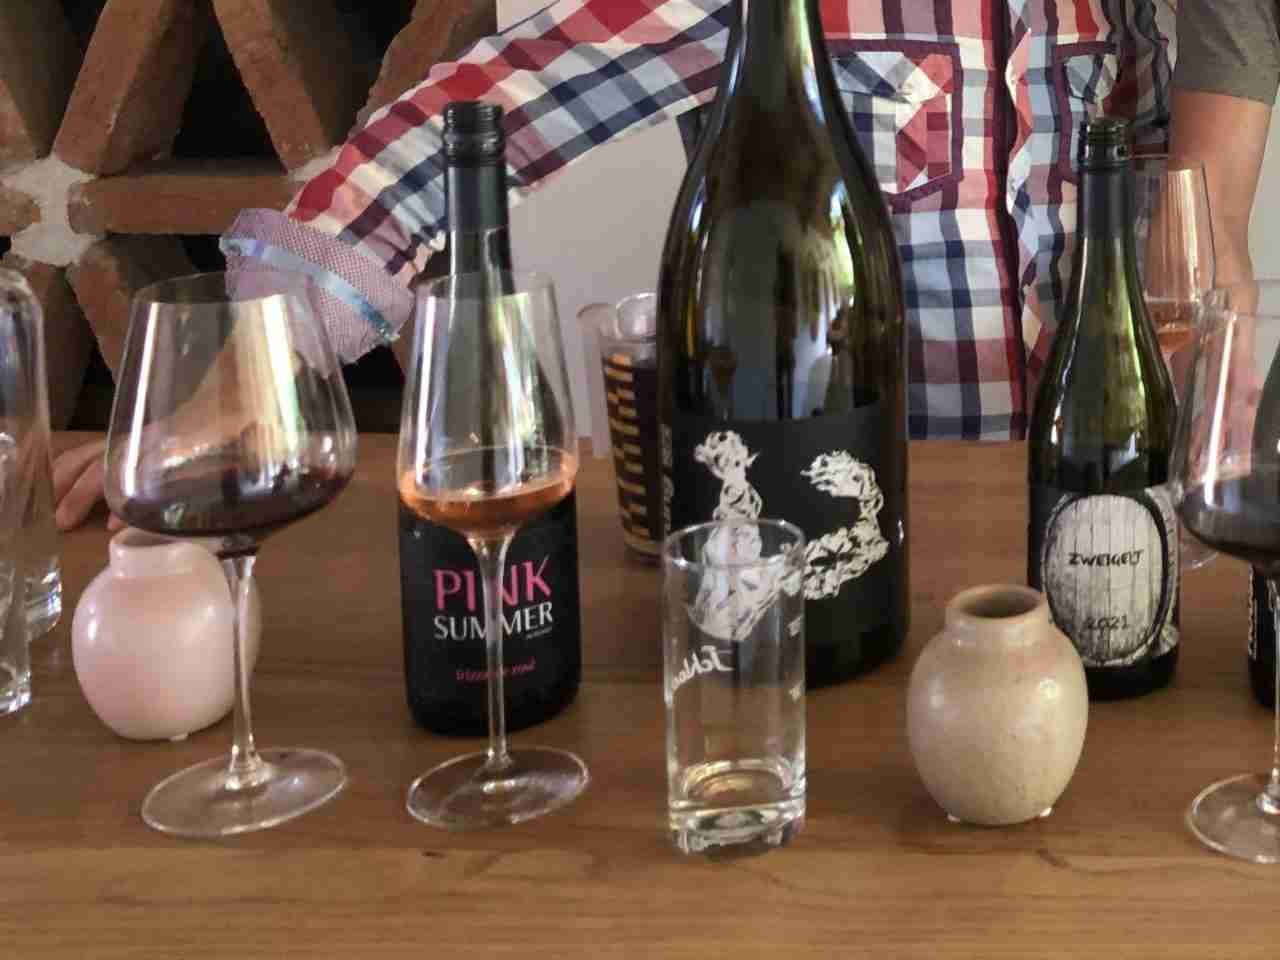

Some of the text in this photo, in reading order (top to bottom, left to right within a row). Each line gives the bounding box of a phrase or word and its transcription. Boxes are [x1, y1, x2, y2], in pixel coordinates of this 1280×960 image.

[1068, 548, 1145, 568] ZWEIGELT
[433, 555, 552, 612] PINK
[433, 601, 554, 641] SUMMER
[1084, 614, 1129, 631] 2021
